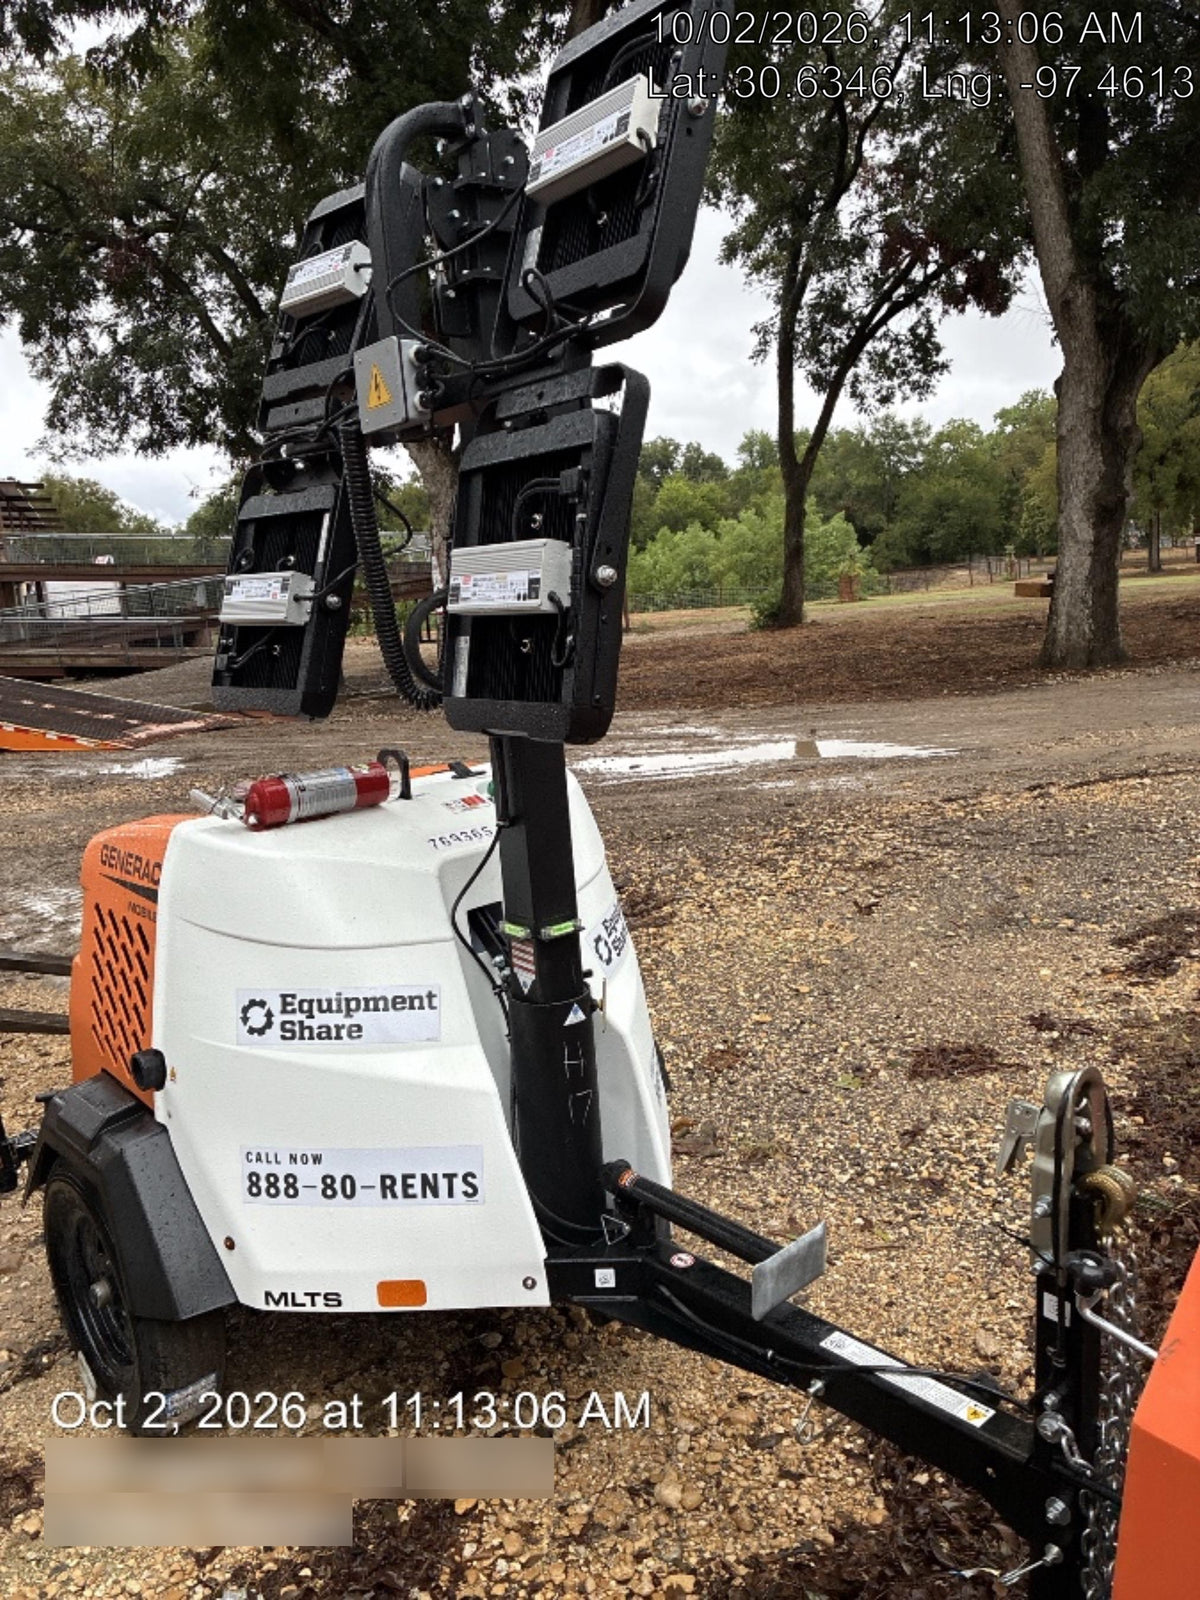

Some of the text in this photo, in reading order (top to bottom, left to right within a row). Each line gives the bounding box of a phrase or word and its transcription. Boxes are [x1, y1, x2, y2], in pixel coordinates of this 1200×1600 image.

[427, 825, 494, 850] 769365
[100, 843, 162, 886] GENERAC
[278, 989, 438, 1020] Equipment
[278, 1019, 364, 1042] Share
[245, 1151, 323, 1166] CALL NOW
[246, 1170, 480, 1201] 888-80-RENTS
[263, 1289, 343, 1308] MLTS
